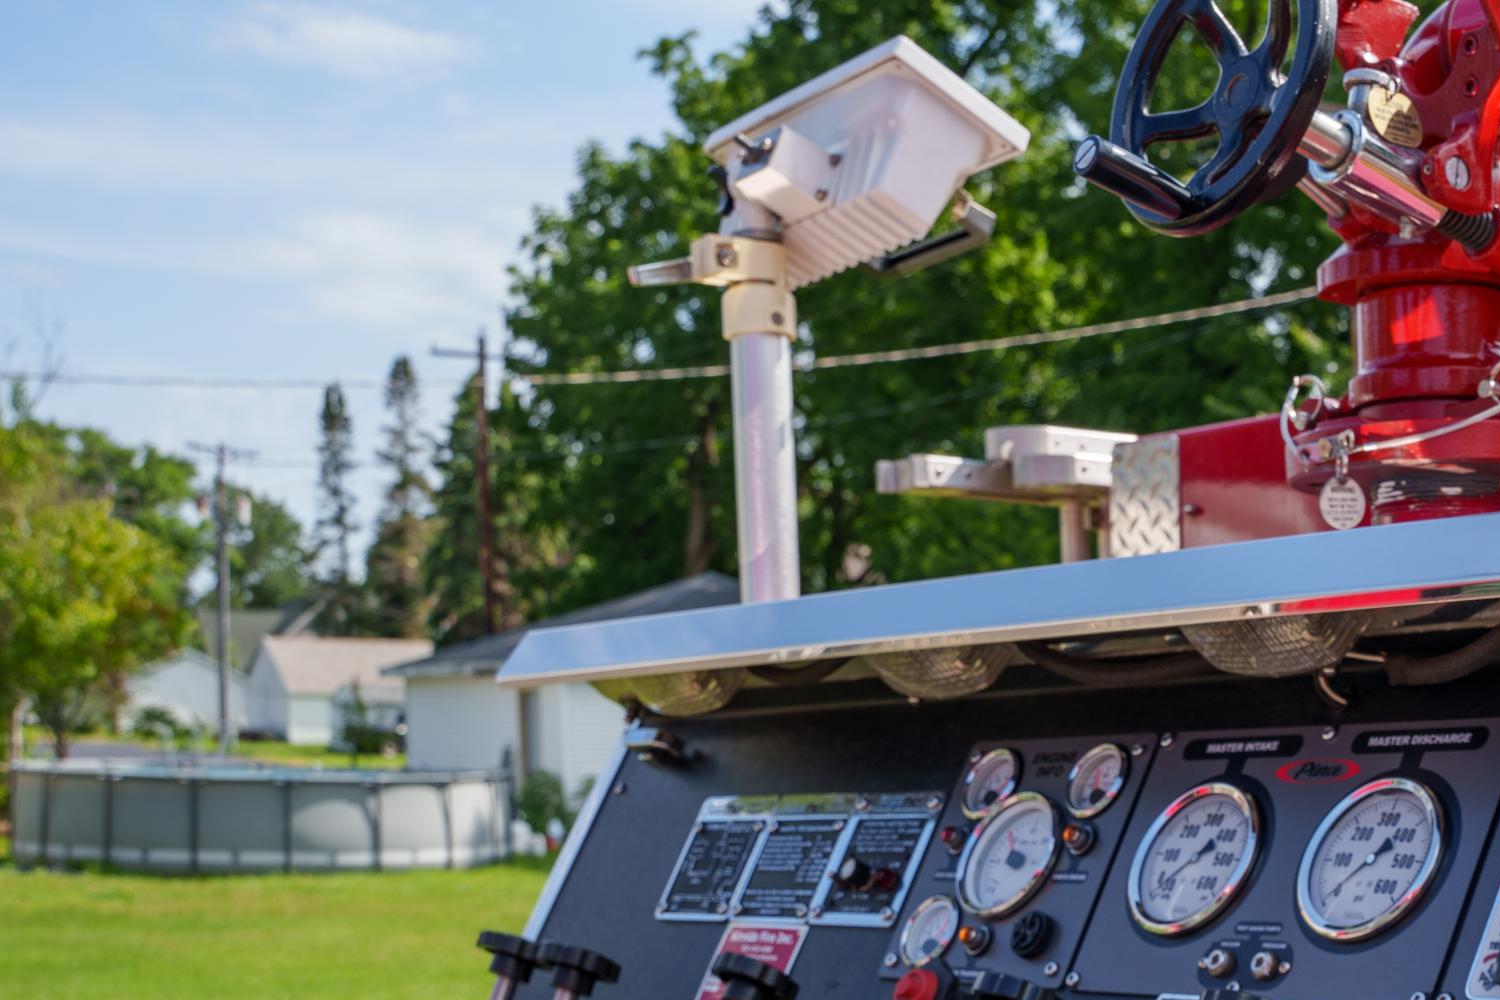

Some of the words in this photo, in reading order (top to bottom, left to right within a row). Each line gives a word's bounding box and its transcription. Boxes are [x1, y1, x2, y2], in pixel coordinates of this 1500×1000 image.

[1206, 743, 1242, 754] MASTER
[1244, 740, 1280, 752] INTAKE
[1368, 735, 1409, 747] MASTER
[1411, 733, 1472, 745] DISCHARGE
[1203, 813, 1225, 827] 300
[1377, 812, 1401, 827] 300
[1180, 825, 1200, 839] 200
[1216, 828, 1237, 843] 400
[1351, 827, 1374, 842] 200
[1393, 828, 1416, 843] 400
[1164, 849, 1181, 862] 100
[1212, 852, 1234, 867] 500
[1334, 853, 1353, 867] 100
[1391, 854, 1415, 869] 500
[1196, 876, 1217, 890] 600
[1374, 880, 1398, 895] 600
